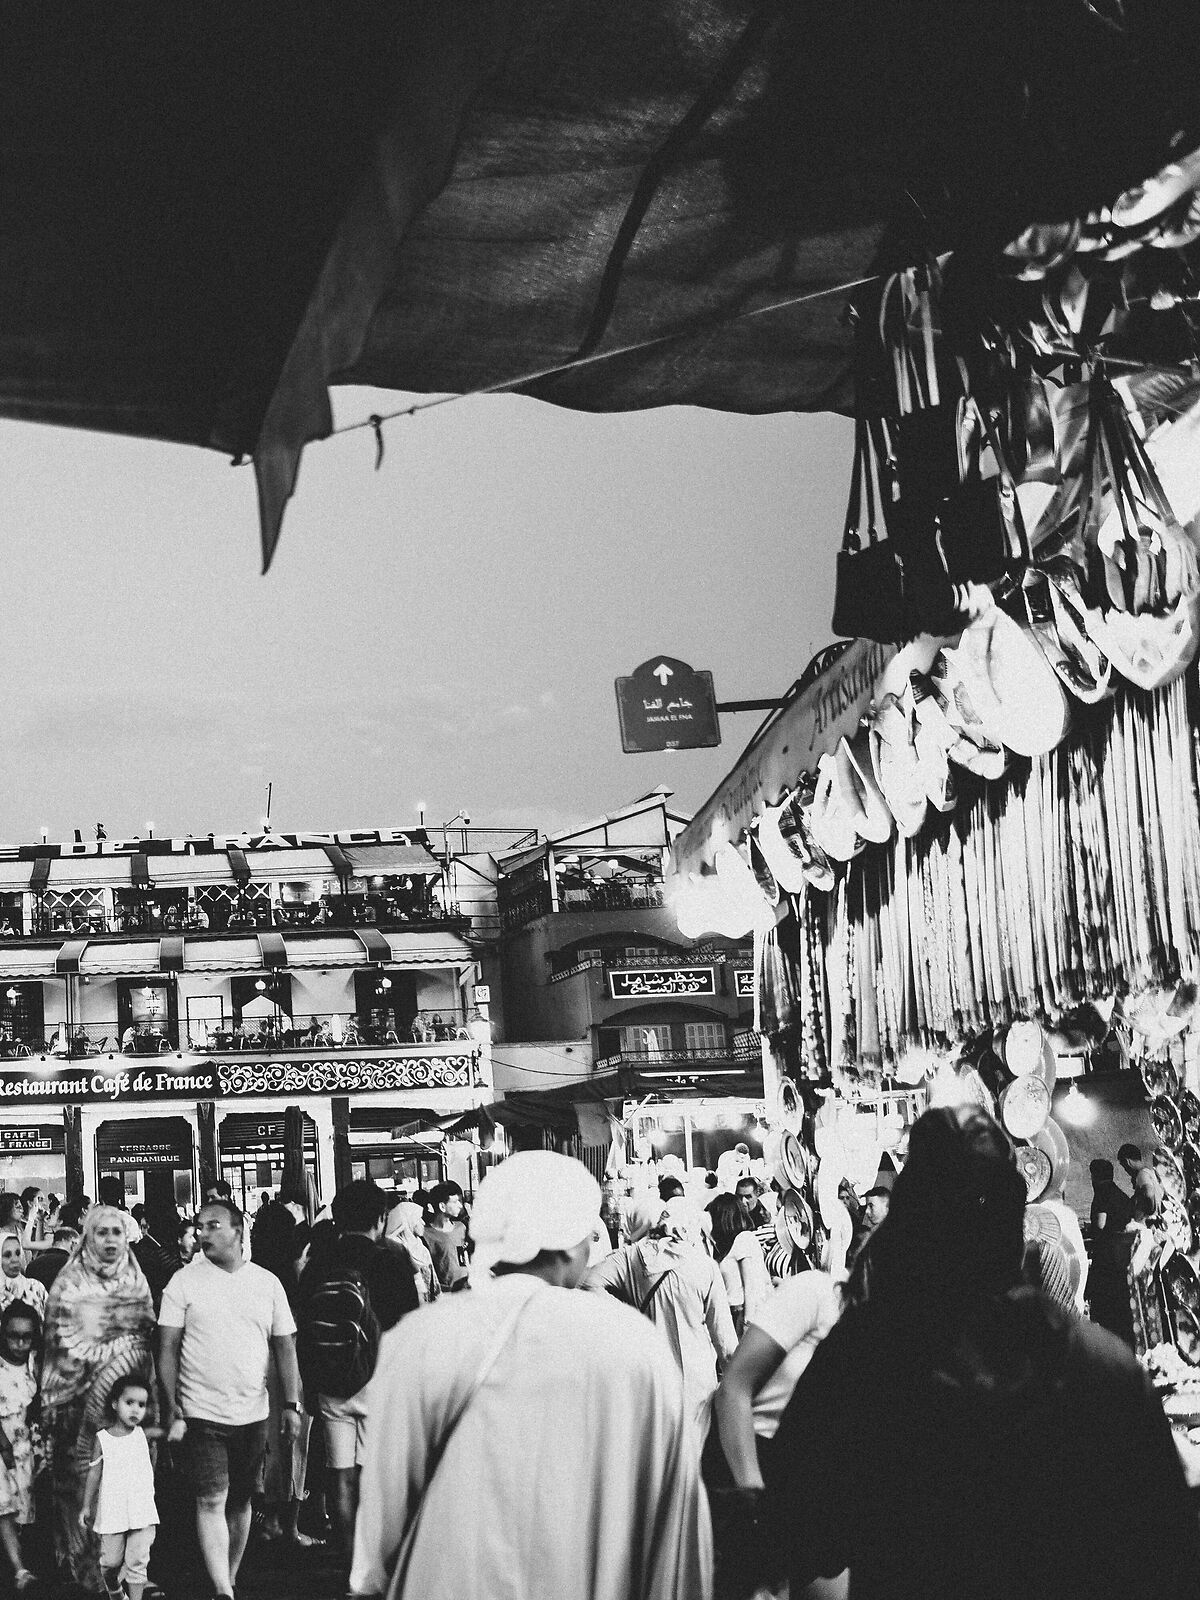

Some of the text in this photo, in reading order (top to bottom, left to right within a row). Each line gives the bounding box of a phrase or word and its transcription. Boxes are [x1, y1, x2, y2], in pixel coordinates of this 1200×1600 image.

[91, 1072, 131, 1099] Café
[133, 1071, 153, 1092] de
[156, 1073, 213, 1091] France
[257, 1125, 277, 1136] CF
[8, 1140, 48, 1149] FRANCE
[109, 1155, 180, 1164] PANORAMIQUE
